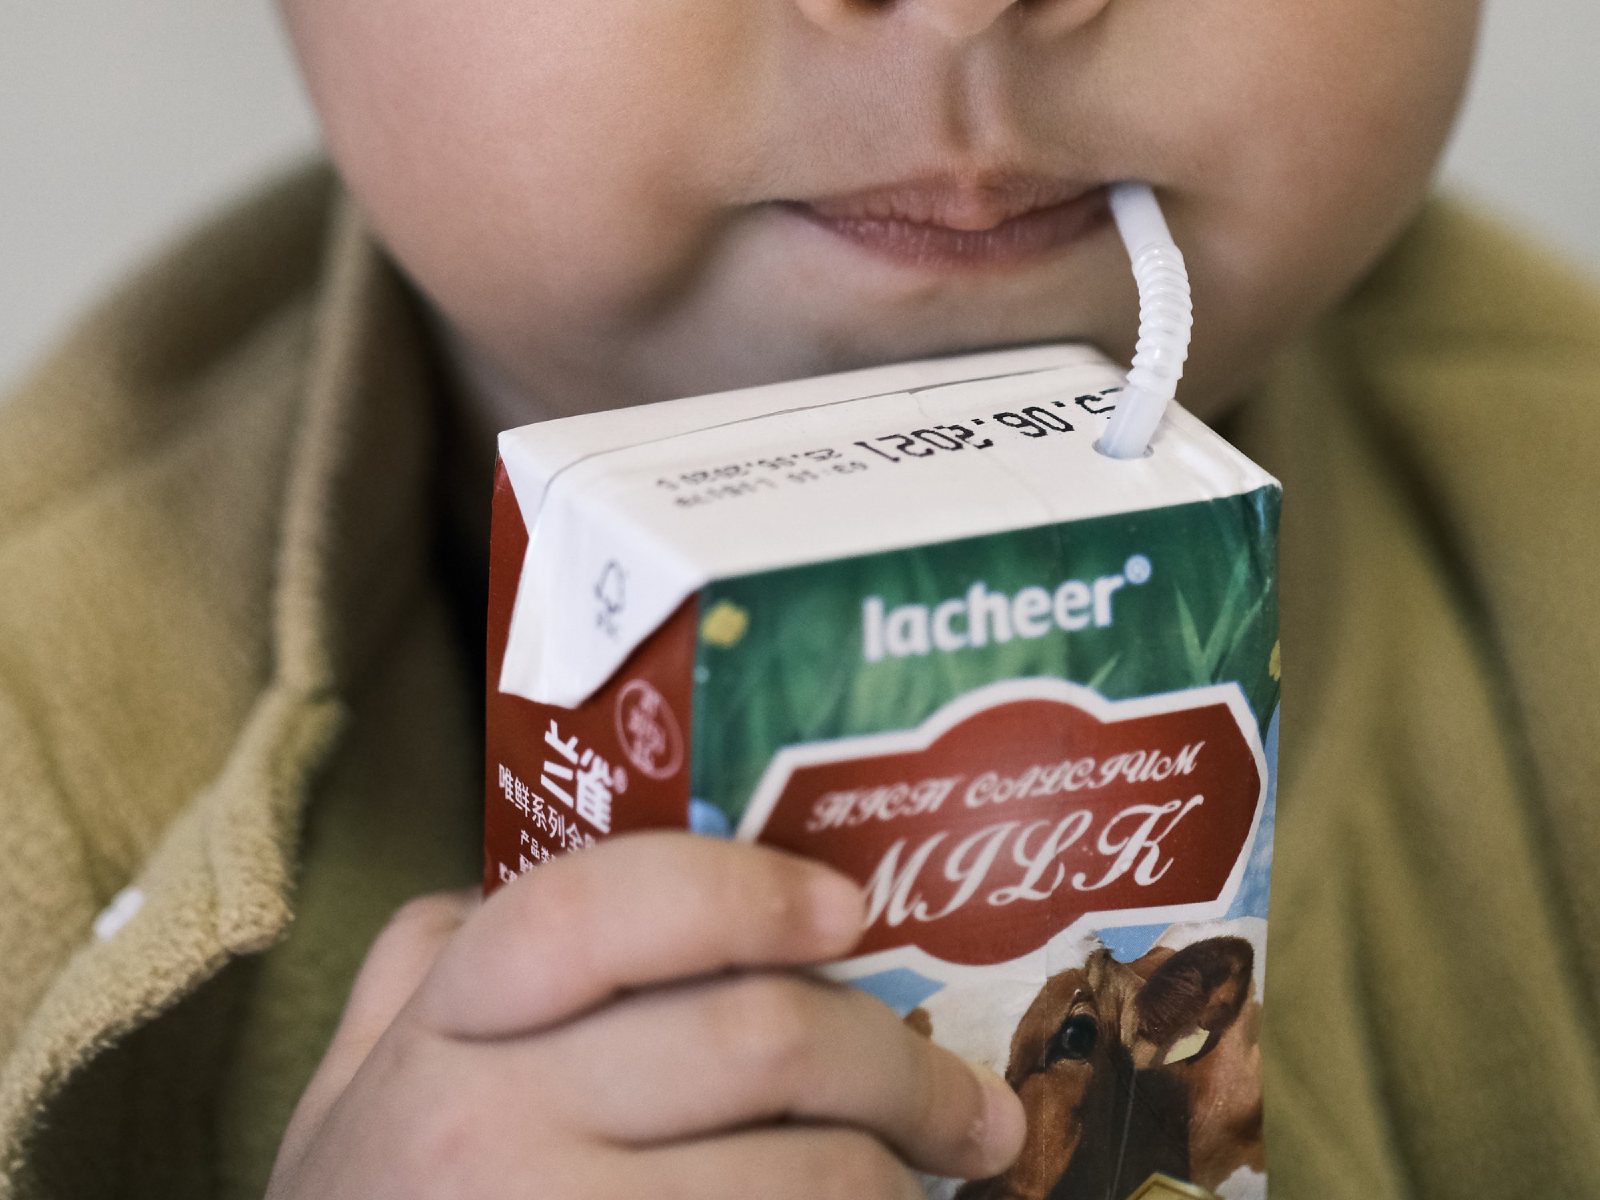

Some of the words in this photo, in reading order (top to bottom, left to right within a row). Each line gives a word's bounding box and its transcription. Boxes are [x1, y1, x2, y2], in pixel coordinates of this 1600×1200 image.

[855, 386, 1124, 464] 5.06.2021
[862, 575, 1126, 663] lacheer
[964, 741, 1207, 809] CALCIUM
[862, 793, 1205, 927] MILK
